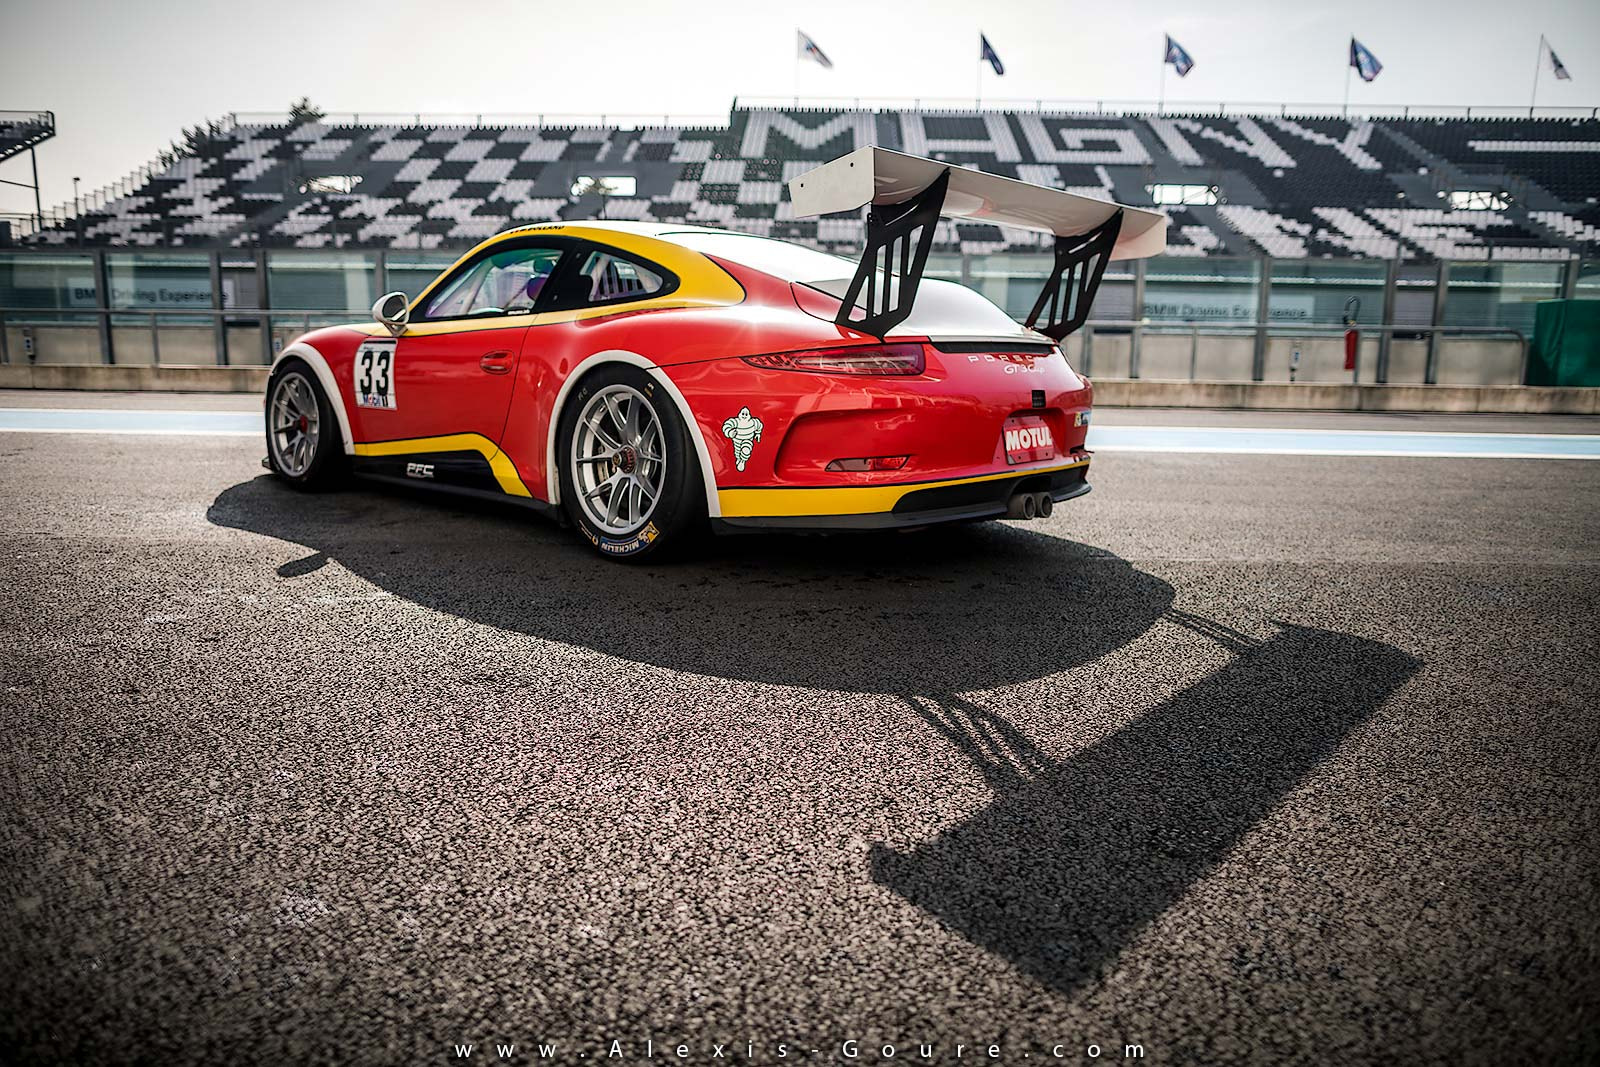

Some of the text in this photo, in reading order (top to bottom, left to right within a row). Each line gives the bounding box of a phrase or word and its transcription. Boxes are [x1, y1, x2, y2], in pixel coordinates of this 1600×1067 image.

[360, 350, 391, 396] 33
[1005, 426, 1053, 451] MOTUL
[600, 540, 640, 553] MICHELIN
